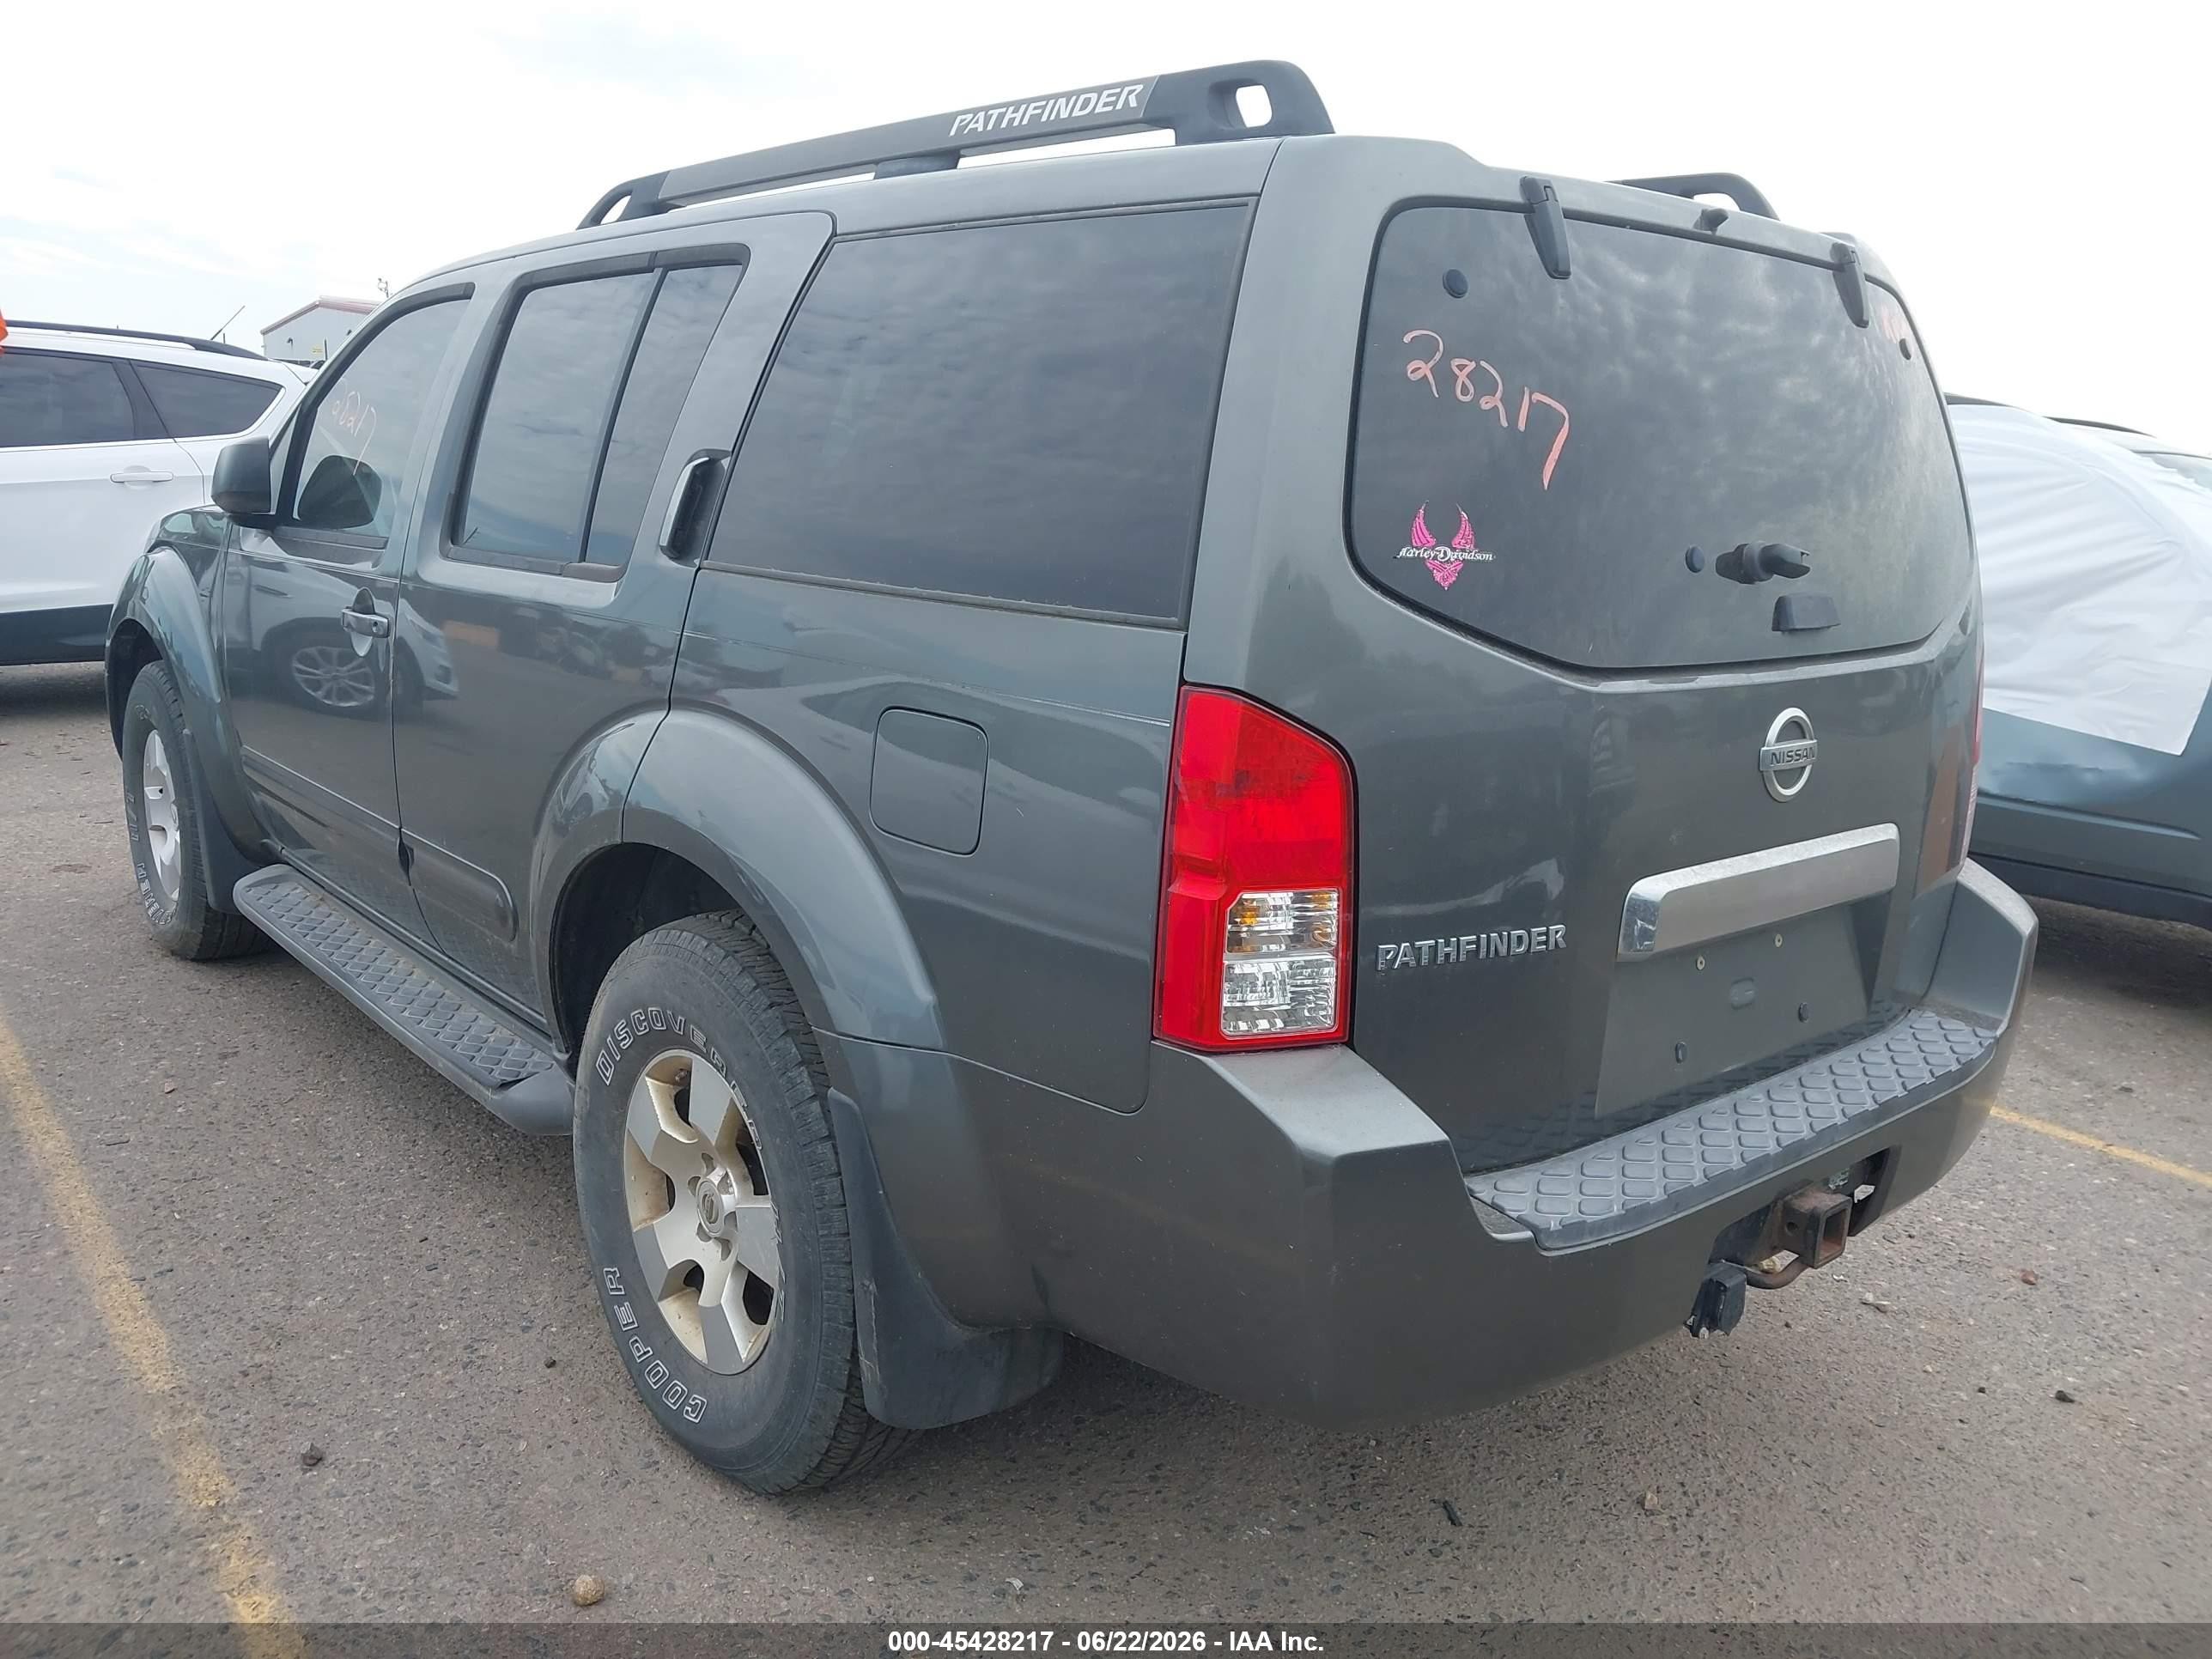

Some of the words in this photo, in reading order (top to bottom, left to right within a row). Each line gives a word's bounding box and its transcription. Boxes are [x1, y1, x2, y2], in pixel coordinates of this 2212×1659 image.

[949, 84, 1144, 137] PATHFINDER
[1403, 330, 1570, 490] 28217
[1771, 746, 1815, 765] NISSAN
[1376, 924, 1567, 971] PATHFINDER
[604, 1267, 708, 1423] COOPER
